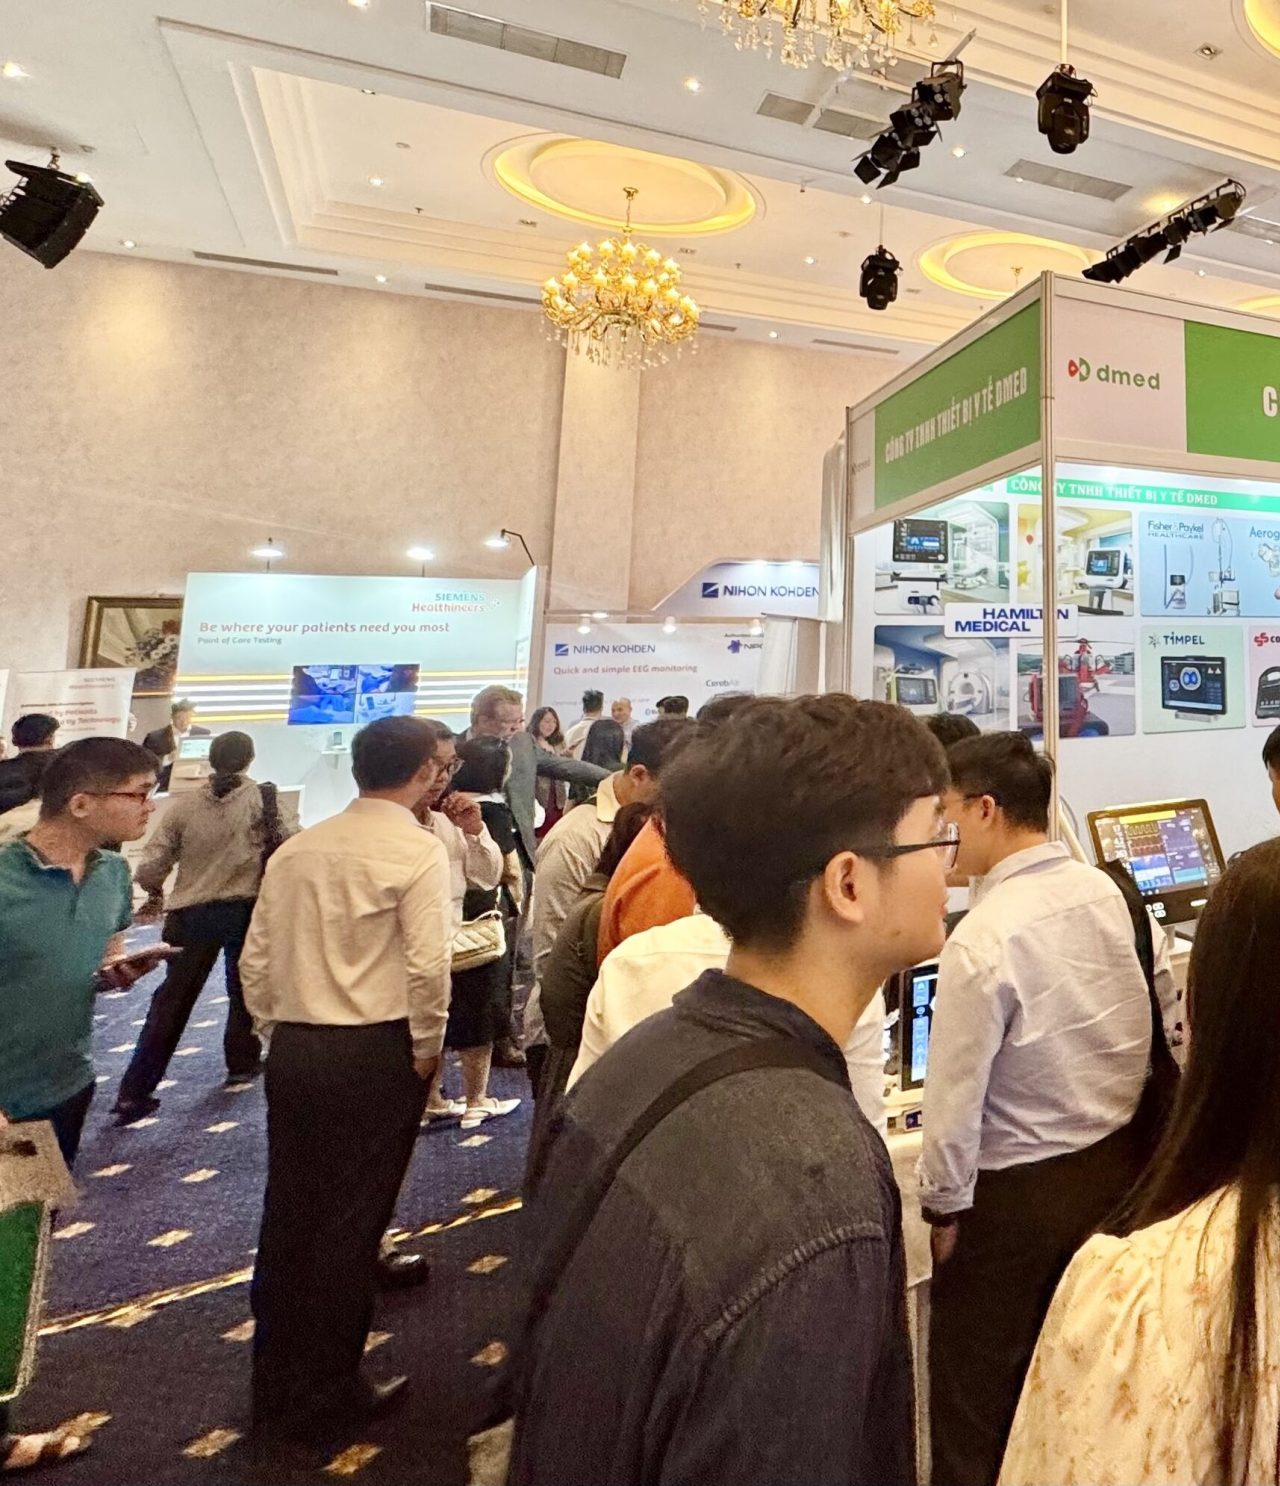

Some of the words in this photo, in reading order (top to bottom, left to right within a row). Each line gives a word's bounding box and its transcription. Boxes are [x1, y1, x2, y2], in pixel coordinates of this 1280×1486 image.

[1096, 363, 1160, 390] dmed
[937, 396, 961, 438] THIẾT
[973, 391, 980, 418] Y
[981, 375, 994, 414] TẾ
[995, 367, 1028, 408] DMED
[1067, 483, 1103, 497] TNHH
[1187, 493, 1218, 505] DMED
[1148, 520, 1172, 531] Fisher
[435, 593, 485, 601] SIEMENS
[723, 585, 767, 597] NIHON
[412, 602, 485, 612] Healthineers
[983, 608, 1069, 620] HAMILTN
[199, 622, 218, 632] Be
[221, 622, 264, 632] where
[266, 624, 298, 634] your
[301, 622, 356, 635] patients
[360, 622, 390, 632] need
[392, 625, 415, 634] you
[419, 622, 450, 632] most
[955, 621, 1030, 632] MEDICAL
[573, 644, 610, 654] NIHON
[612, 644, 656, 654] KOHDEN
[553, 666, 581, 675] Quick
[583, 666, 599, 674] and
[601, 665, 630, 675] simple
[632, 664, 650, 673] EEG
[651, 663, 698, 674] monitoring
